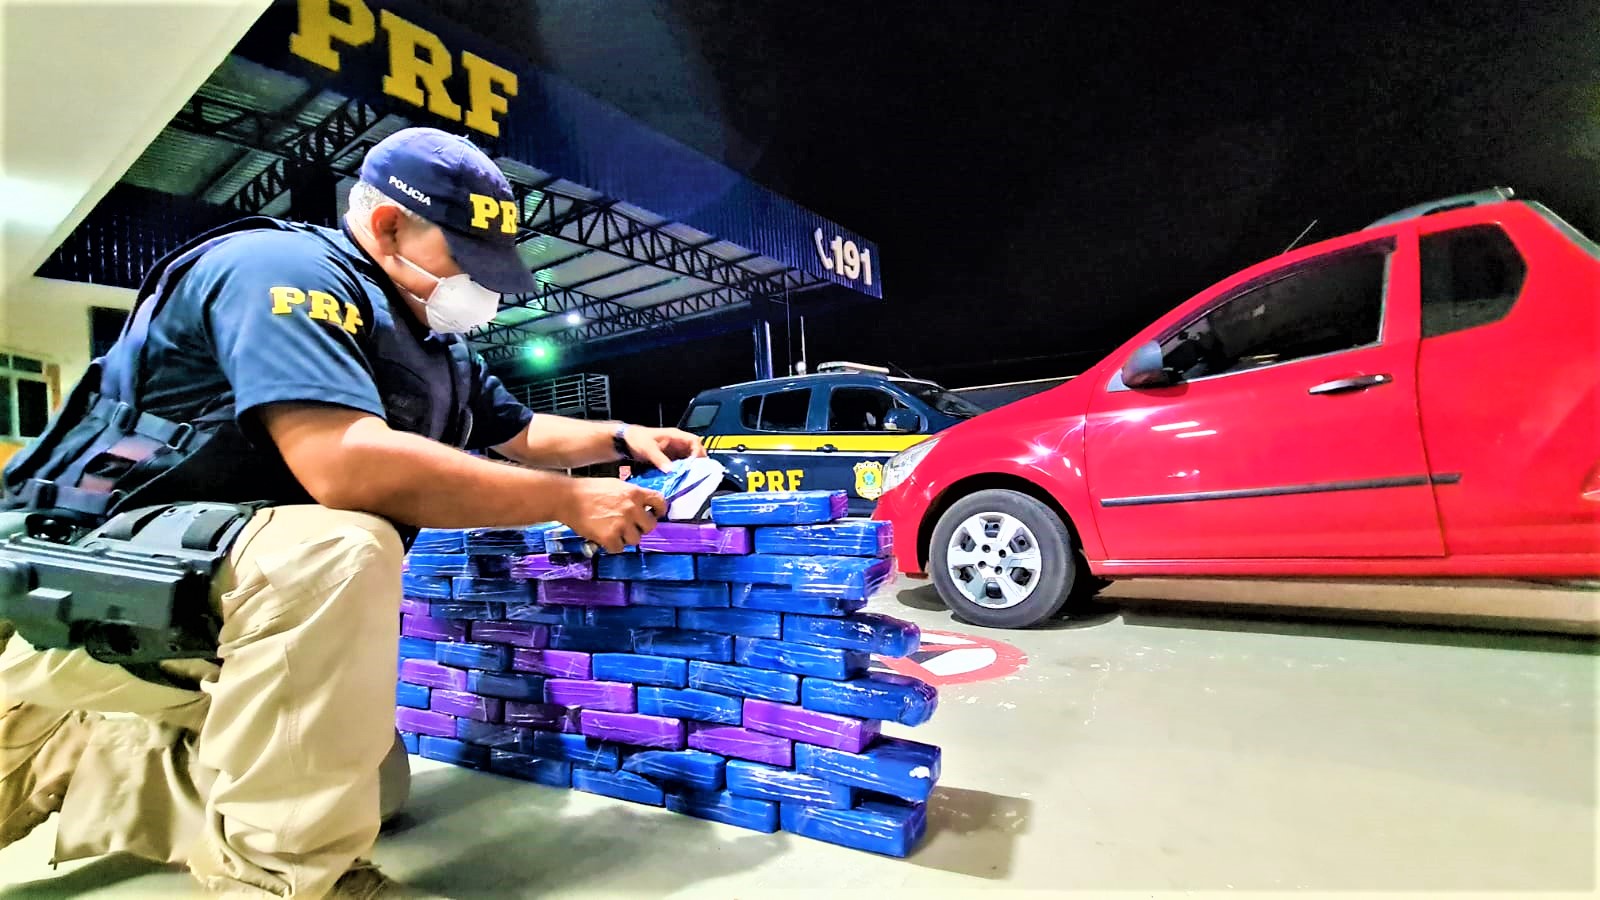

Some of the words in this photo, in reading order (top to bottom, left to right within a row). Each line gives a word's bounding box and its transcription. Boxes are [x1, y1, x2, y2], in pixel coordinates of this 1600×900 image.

[290, 0, 518, 137] PRF
[469, 193, 517, 234] PR
[830, 235, 872, 286] 191
[269, 286, 364, 335] PRF
[747, 469, 804, 492] PRF
